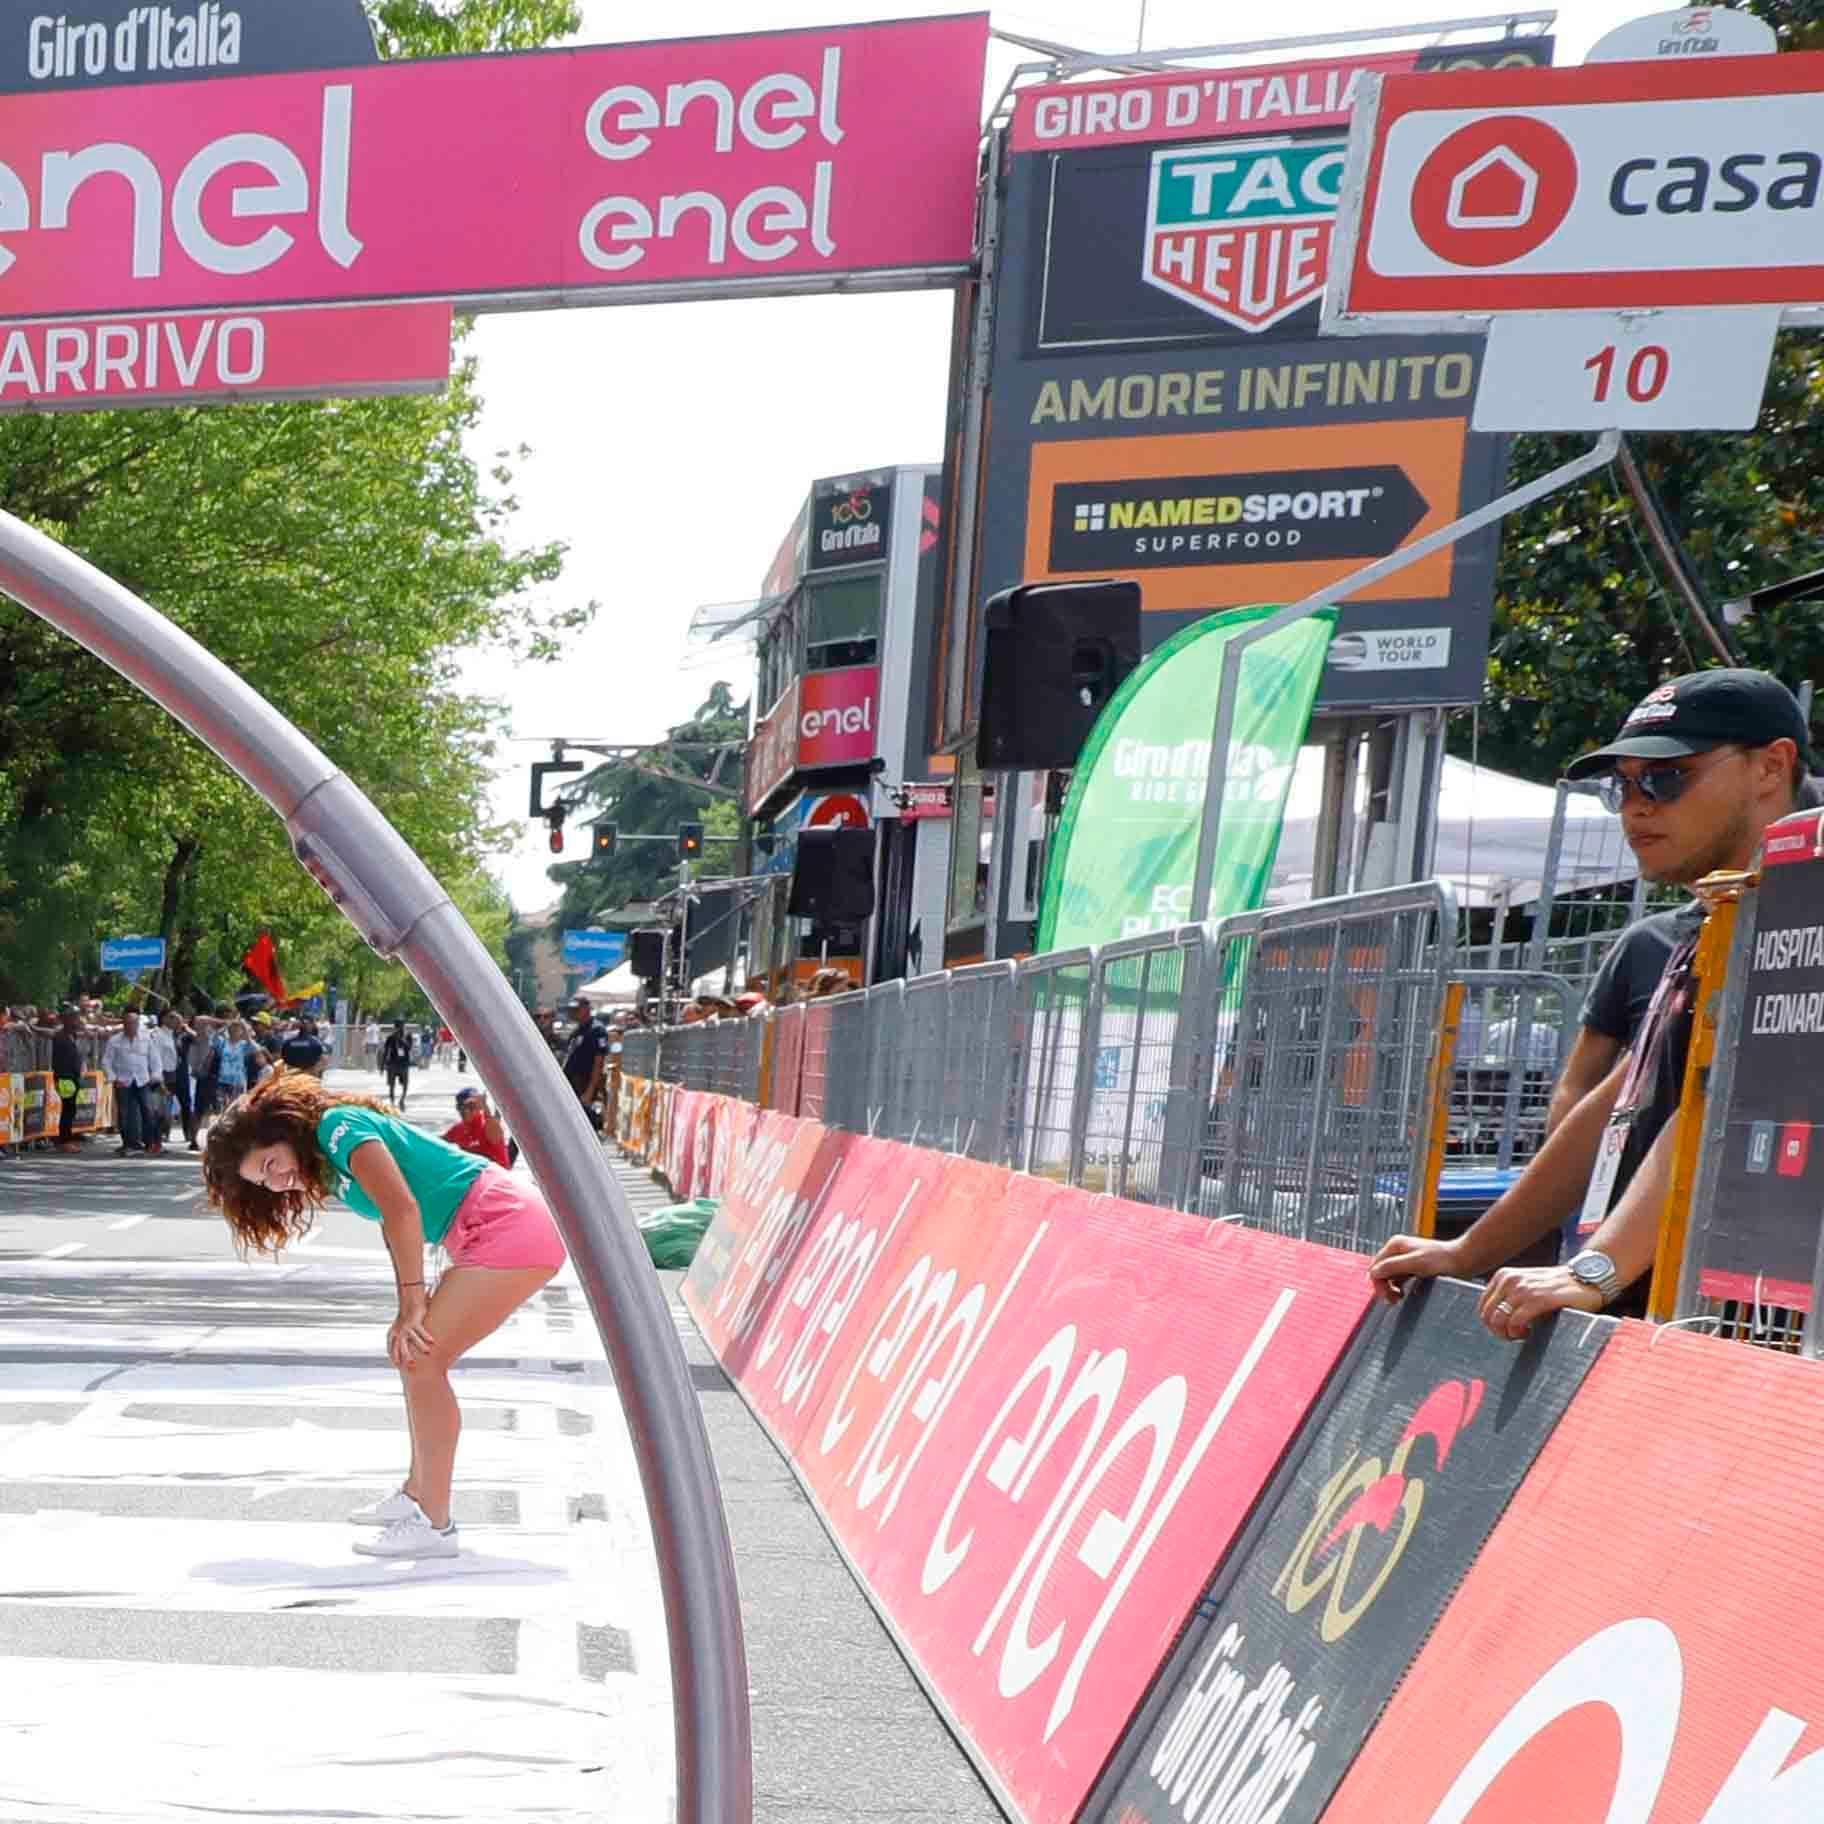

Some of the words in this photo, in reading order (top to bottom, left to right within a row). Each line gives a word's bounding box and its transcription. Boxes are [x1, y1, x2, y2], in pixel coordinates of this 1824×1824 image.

[29, 15, 107, 79] Giro
[115, 2, 241, 72] d'Italia
[585, 46, 844, 160] enel
[1034, 84, 1151, 139] GIRO
[579, 160, 836, 270] enel
[1609, 152, 1823, 216] casa
[1160, 226, 1336, 312] HEUE
[1031, 370, 1224, 424] AMORE
[1238, 353, 1473, 411] INFINITO
[1583, 345, 1670, 402] 10
[1135, 529, 1301, 554] SUPERFOOD
[1377, 636, 1438, 654] WORLD
[1378, 651, 1424, 666] TOUR
[802, 697, 871, 738] enel
[757, 1177, 920, 1416] enel
[820, 1219, 1050, 1532] enel
[920, 1286, 1298, 1745] enel
